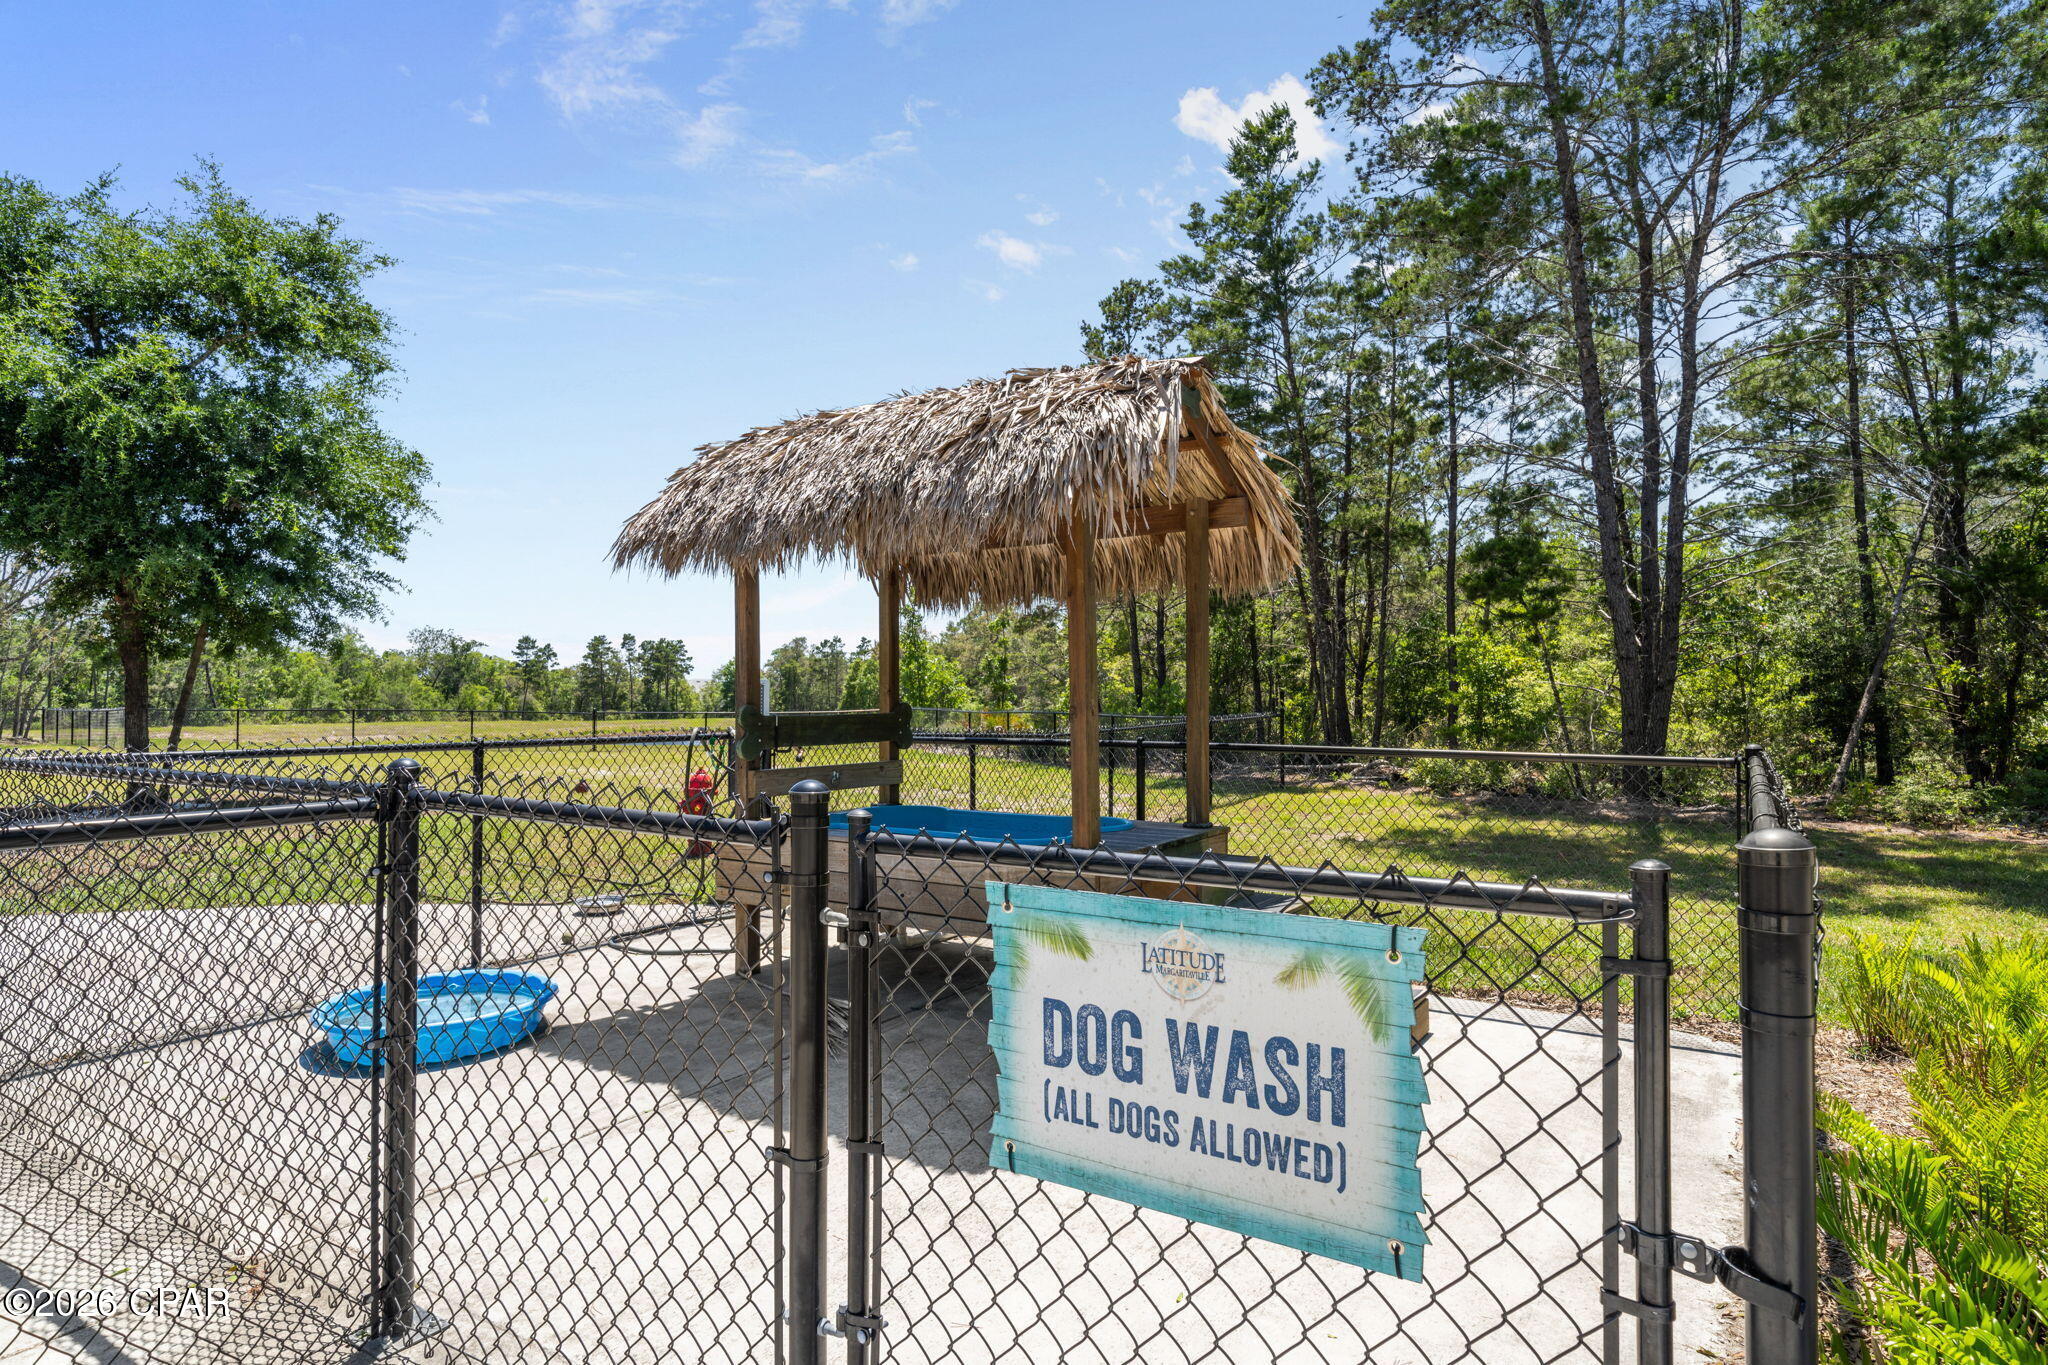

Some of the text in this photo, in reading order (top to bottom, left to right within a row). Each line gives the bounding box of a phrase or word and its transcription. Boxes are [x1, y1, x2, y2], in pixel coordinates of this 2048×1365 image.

[1140, 941, 1226, 983] LATITUDE
[1155, 963, 1210, 981] MARGARITAVILLE
[1042, 996, 1346, 1128] DOG WASH
[1043, 1077, 1346, 1194] (ALL DOGS ALLOWED)
